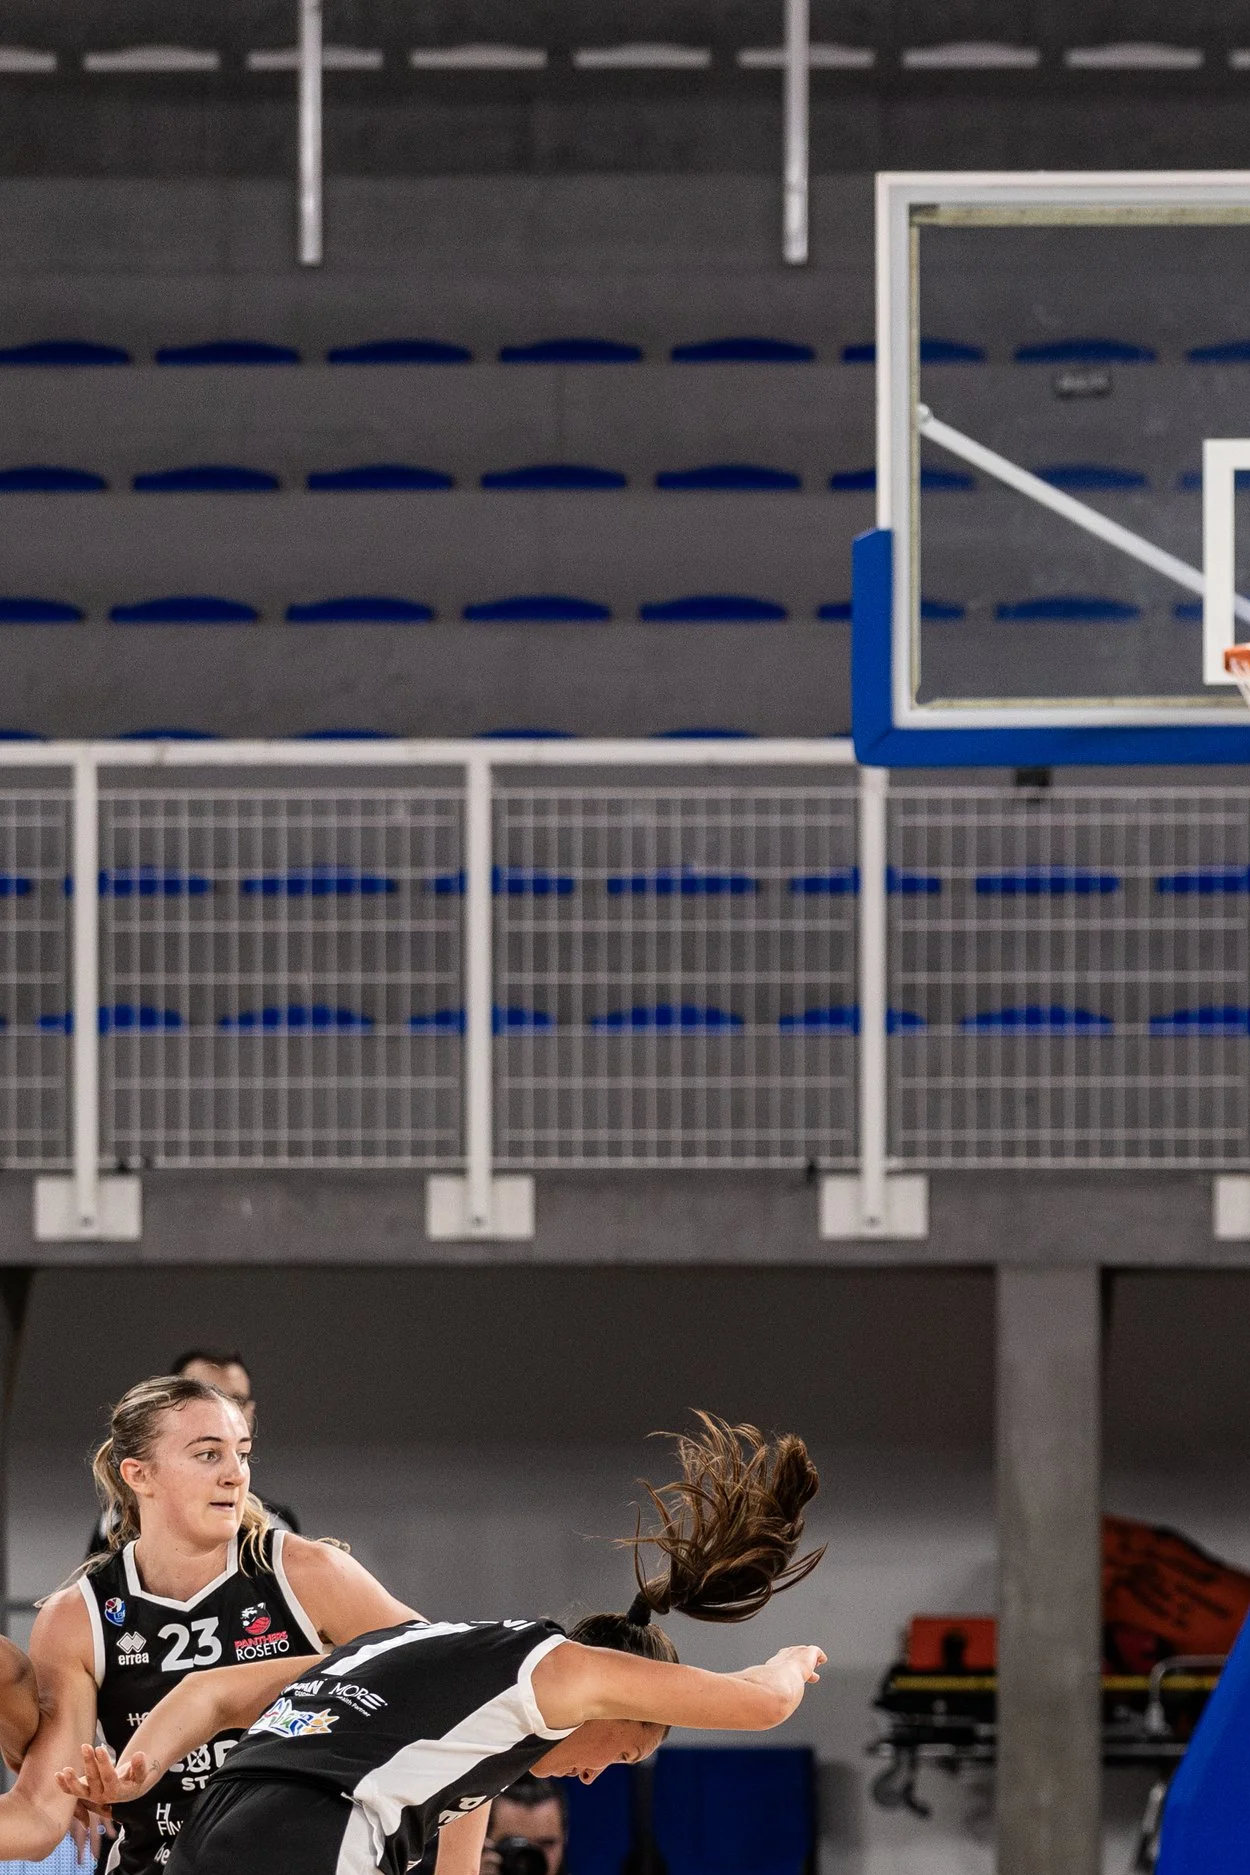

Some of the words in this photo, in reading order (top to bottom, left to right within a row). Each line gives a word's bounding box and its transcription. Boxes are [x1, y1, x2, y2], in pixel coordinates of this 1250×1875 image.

[157, 1616, 223, 1672] 23
[234, 1630, 289, 1649] PANTHERS
[118, 1652, 150, 1665] errea
[236, 1639, 290, 1661] ROSETO
